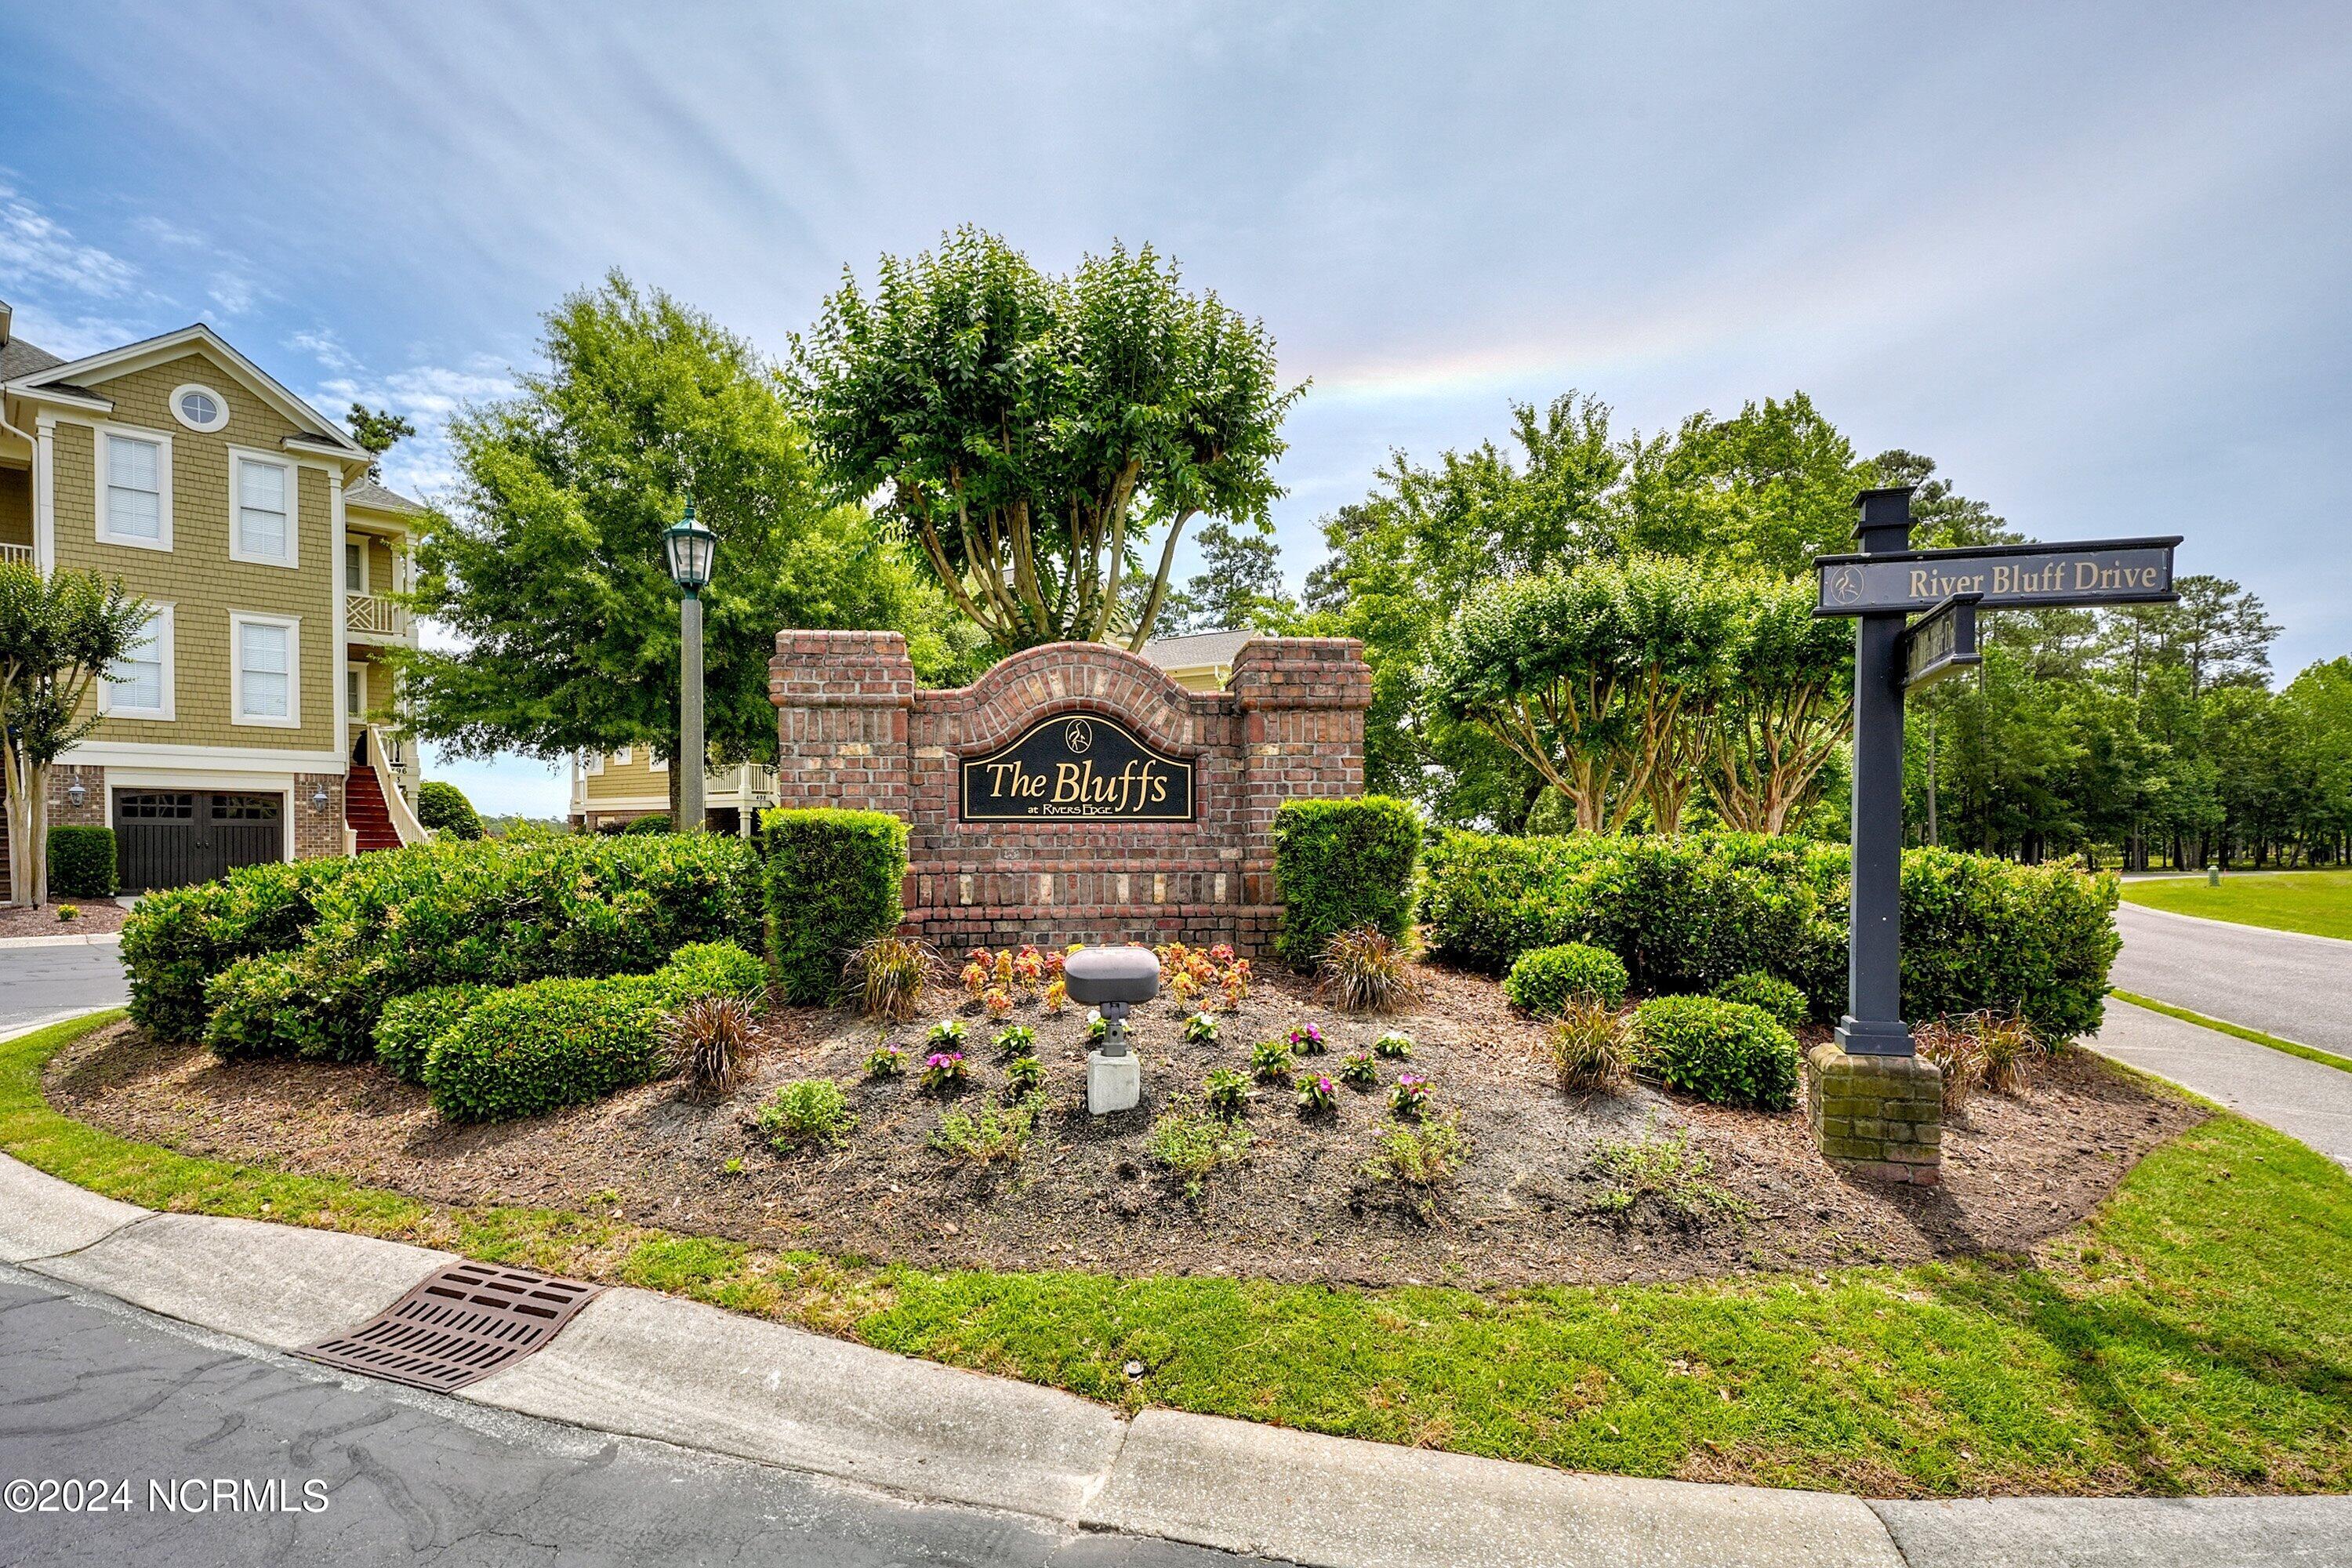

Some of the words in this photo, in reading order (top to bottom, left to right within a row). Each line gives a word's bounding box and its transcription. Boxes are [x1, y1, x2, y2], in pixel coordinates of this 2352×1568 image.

[1908, 568, 1984, 597] River
[1991, 561, 2065, 593] Bluff
[2074, 560, 2157, 590] Drive
[986, 760, 1047, 797] The
[1050, 759, 1167, 812] Bluffs
